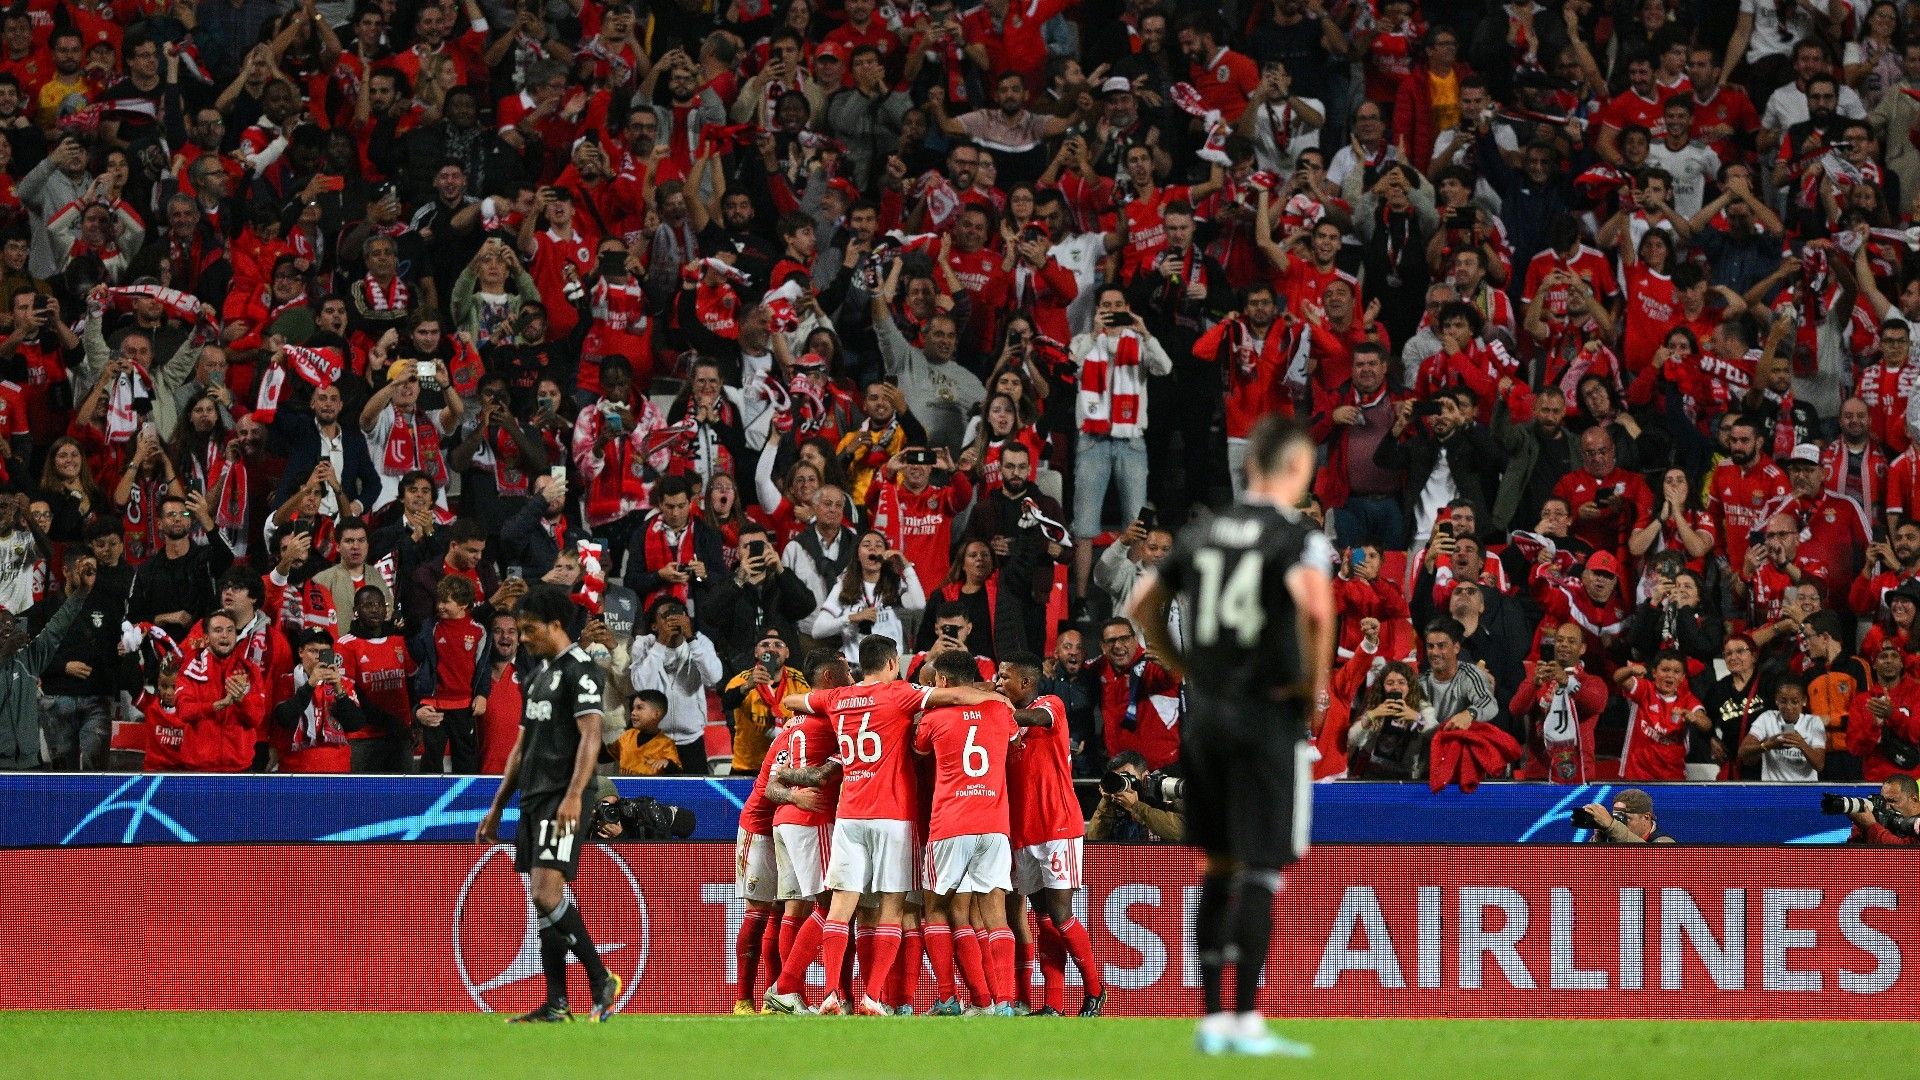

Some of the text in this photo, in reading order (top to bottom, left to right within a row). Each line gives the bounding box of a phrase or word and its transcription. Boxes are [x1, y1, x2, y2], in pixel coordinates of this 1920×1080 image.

[903, 513, 943, 527] mirates
[1193, 547, 1264, 645] 14
[963, 711, 982, 720] BAH
[837, 711, 882, 765] 66
[962, 725, 990, 777] 6
[955, 789, 996, 798] FOUNDATION
[1050, 850, 1069, 873] 61
[1312, 886, 1902, 994] AIRLINES
